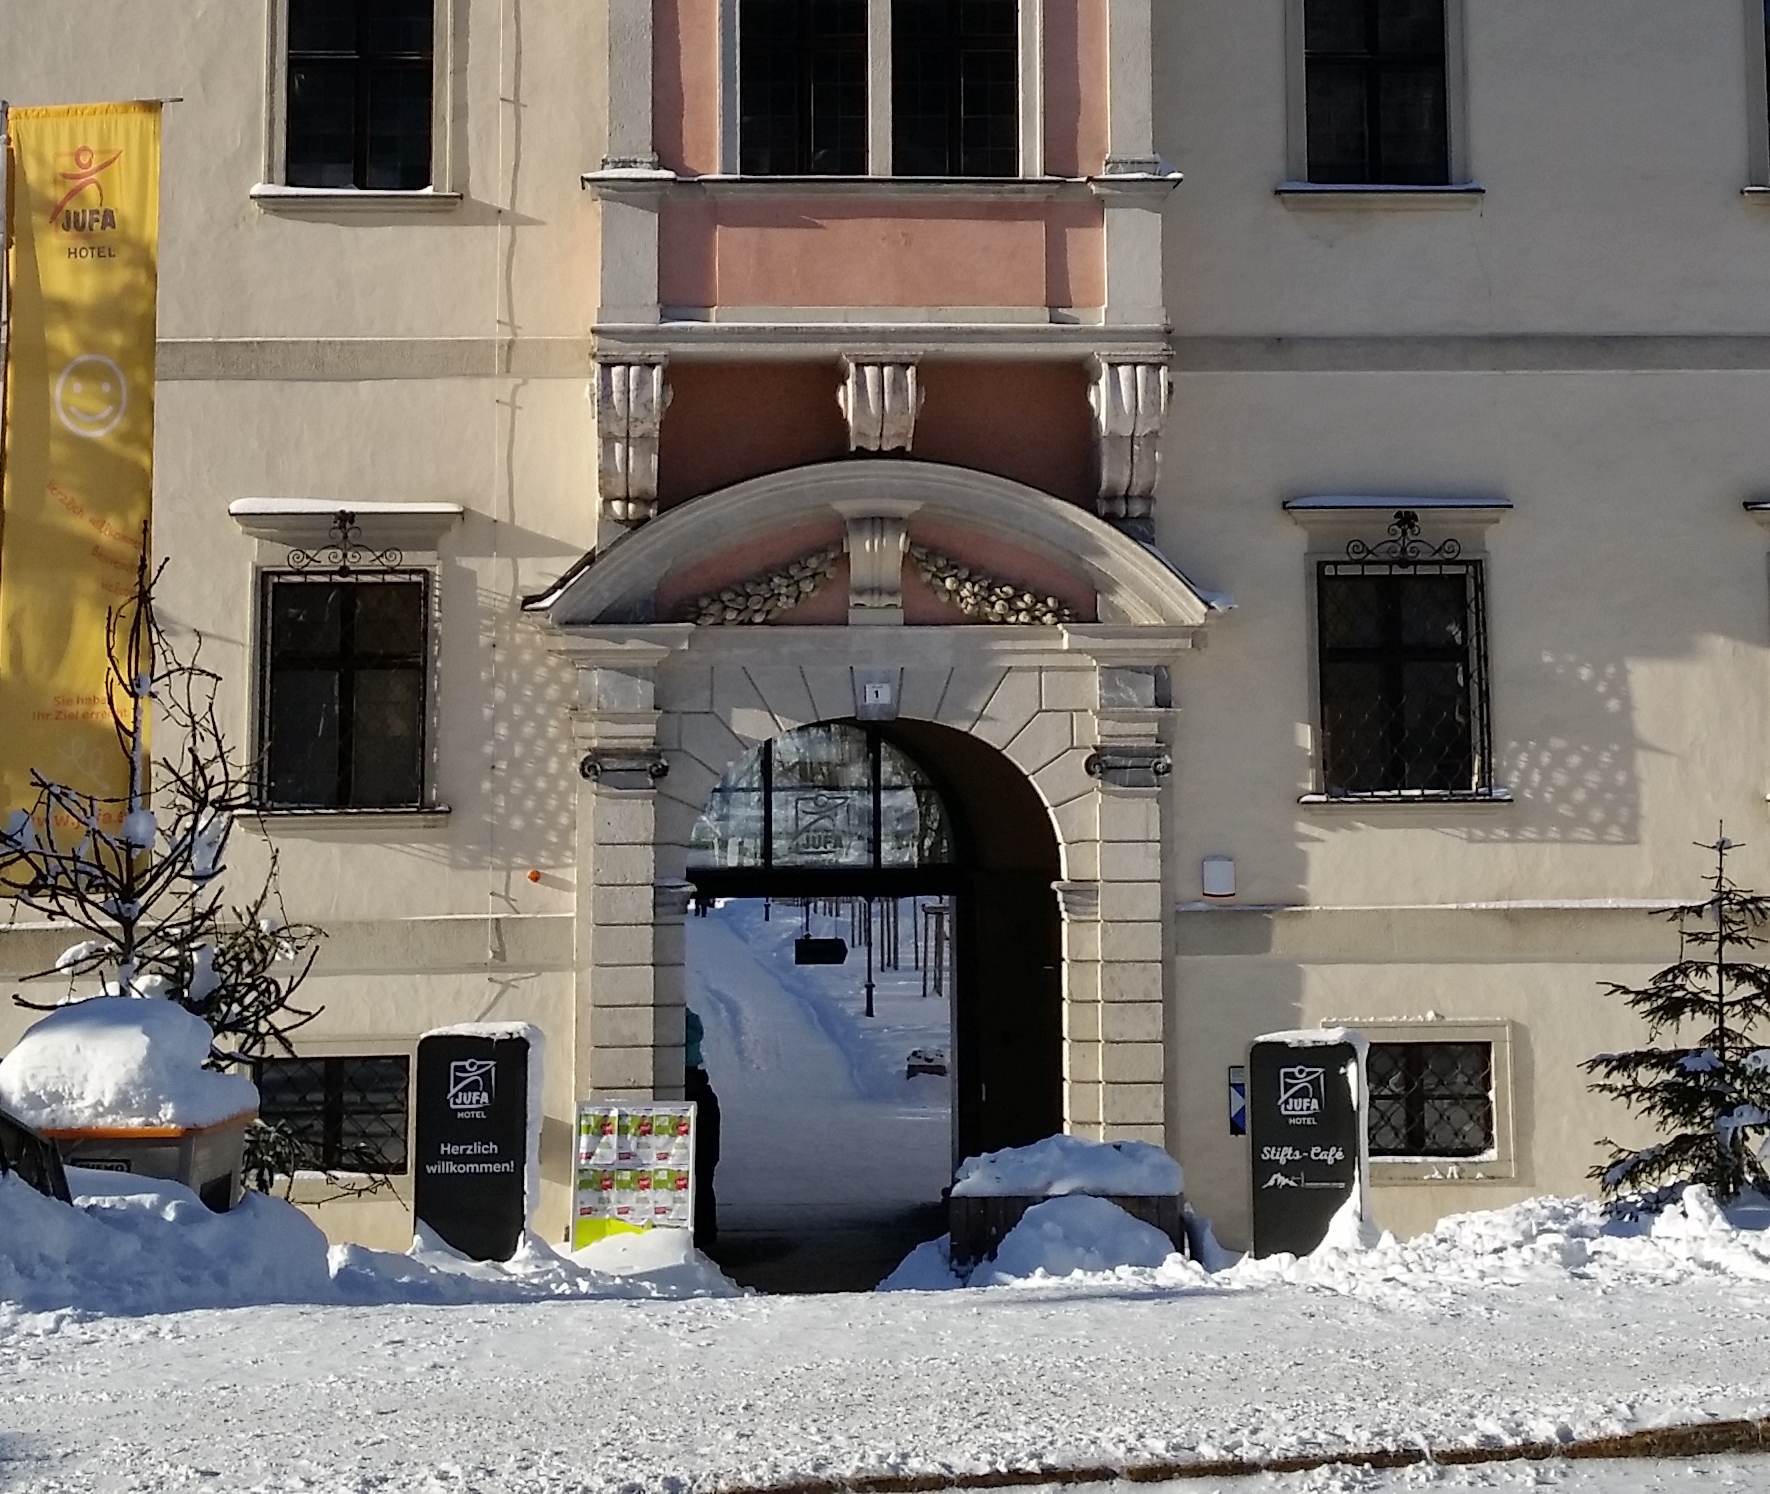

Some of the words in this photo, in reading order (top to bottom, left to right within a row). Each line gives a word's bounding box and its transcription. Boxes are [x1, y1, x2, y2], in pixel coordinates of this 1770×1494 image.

[61, 208, 117, 232] JUFA
[67, 246, 116, 259] HOTEL
[54, 695, 74, 706] Sie
[76, 694, 111, 705] habe
[874, 689, 879, 699] 1
[32, 711, 49, 721] Ihr
[54, 710, 79, 720] Ziel
[455, 1091, 489, 1105] JUFA
[1286, 1097, 1319, 1111] JUFA
[457, 1110, 487, 1119] HOTEL
[1289, 1117, 1317, 1125] HOTEL
[440, 1141, 499, 1155] Herzlich
[1261, 1146, 1345, 1165] Stifts-Café
[425, 1160, 515, 1174] willkommen!
